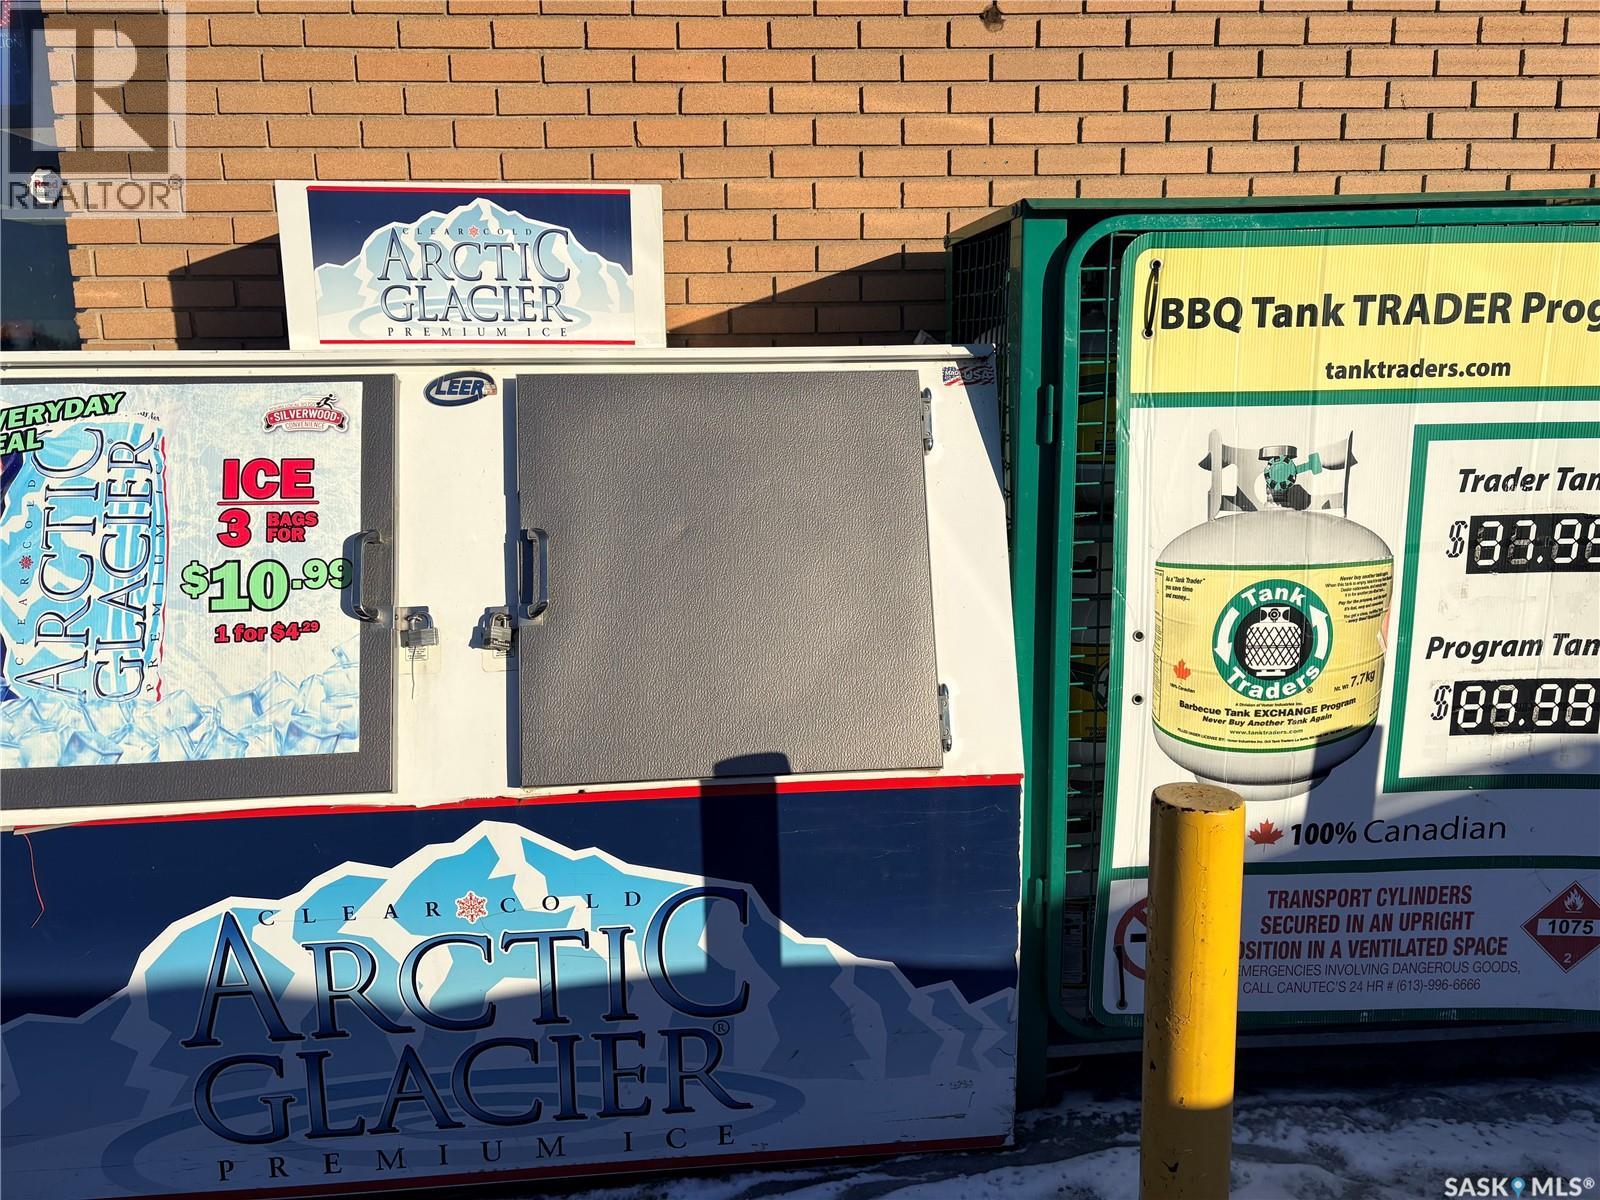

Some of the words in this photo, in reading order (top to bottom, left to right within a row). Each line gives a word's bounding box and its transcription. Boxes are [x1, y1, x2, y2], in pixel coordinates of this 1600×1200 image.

[402, 227, 465, 236] CLEAR
[483, 227, 532, 236] COLD
[377, 227, 571, 282] ARCTIC
[1161, 296, 1243, 333] BBQ
[1252, 293, 1345, 329] Tank
[1353, 291, 1511, 328] TRADER
[387, 327, 508, 338] PREMIUM
[527, 327, 568, 338] ICE
[964, 370, 991, 380] USA
[1325, 358, 1511, 380] tanktraders.com
[435, 379, 485, 396] LEER
[273, 408, 337, 422] SILVERWOOD
[222, 458, 315, 499] ICE
[1459, 466, 1550, 493] Trader
[217, 507, 252, 548] 3
[265, 511, 319, 527] BAGS
[265, 526, 307, 543] FOR
[15, 428, 105, 704] ARCTIC
[180, 557, 354, 613] $10.99
[1240, 586, 1307, 607] Tank
[214, 624, 230, 643] 1
[232, 623, 268, 643] for
[1425, 635, 1544, 664] Program
[1552, 632, 1600, 657] Tan
[1179, 700, 1221, 715] Barbecue
[1225, 708, 1250, 717] Tank
[1254, 705, 1318, 717] EXCHANGE
[1320, 698, 1356, 712] Program
[1202, 715, 1226, 724] Never
[1229, 718, 1245, 727] Buy
[1286, 717, 1307, 726] Tank
[1310, 713, 1332, 723] Again
[1290, 820, 1358, 846] 100%
[1364, 815, 1507, 843] Canadian
[257, 899, 441, 926] CLEAR
[499, 889, 642, 915] COLD
[1268, 888, 1372, 909] TRANSPORT
[1376, 885, 1473, 907] CYLINDERS
[1260, 914, 1340, 934] SECURED
[1345, 914, 1363, 933] IN
[1364, 913, 1394, 933] AN
[1399, 911, 1475, 931] UPRIGHT
[1548, 920, 1594, 935] 1075
[1307, 940, 1325, 959] IN
[1330, 939, 1342, 959] A
[1347, 937, 1448, 959] VENTILATED
[1452, 936, 1509, 956] SPACE
[1560, 952, 1572, 964] 2
[180, 885, 752, 1049] ARCTIC
[1325, 962, 1389, 976] INVOLVING
[1392, 960, 1469, 974] DANGEROUS
[1472, 960, 1520, 974] GOODS,
[1242, 981, 1275, 994] CALL
[1276, 980, 1347, 993] CANUTEC'S
[1351, 981, 1363, 992] 24
[1366, 980, 1383, 992] HR
[1396, 977, 1481, 993] (613)-996-6666
[217, 1134, 567, 1181] PREMIUM
[623, 1123, 737, 1153] ICE
